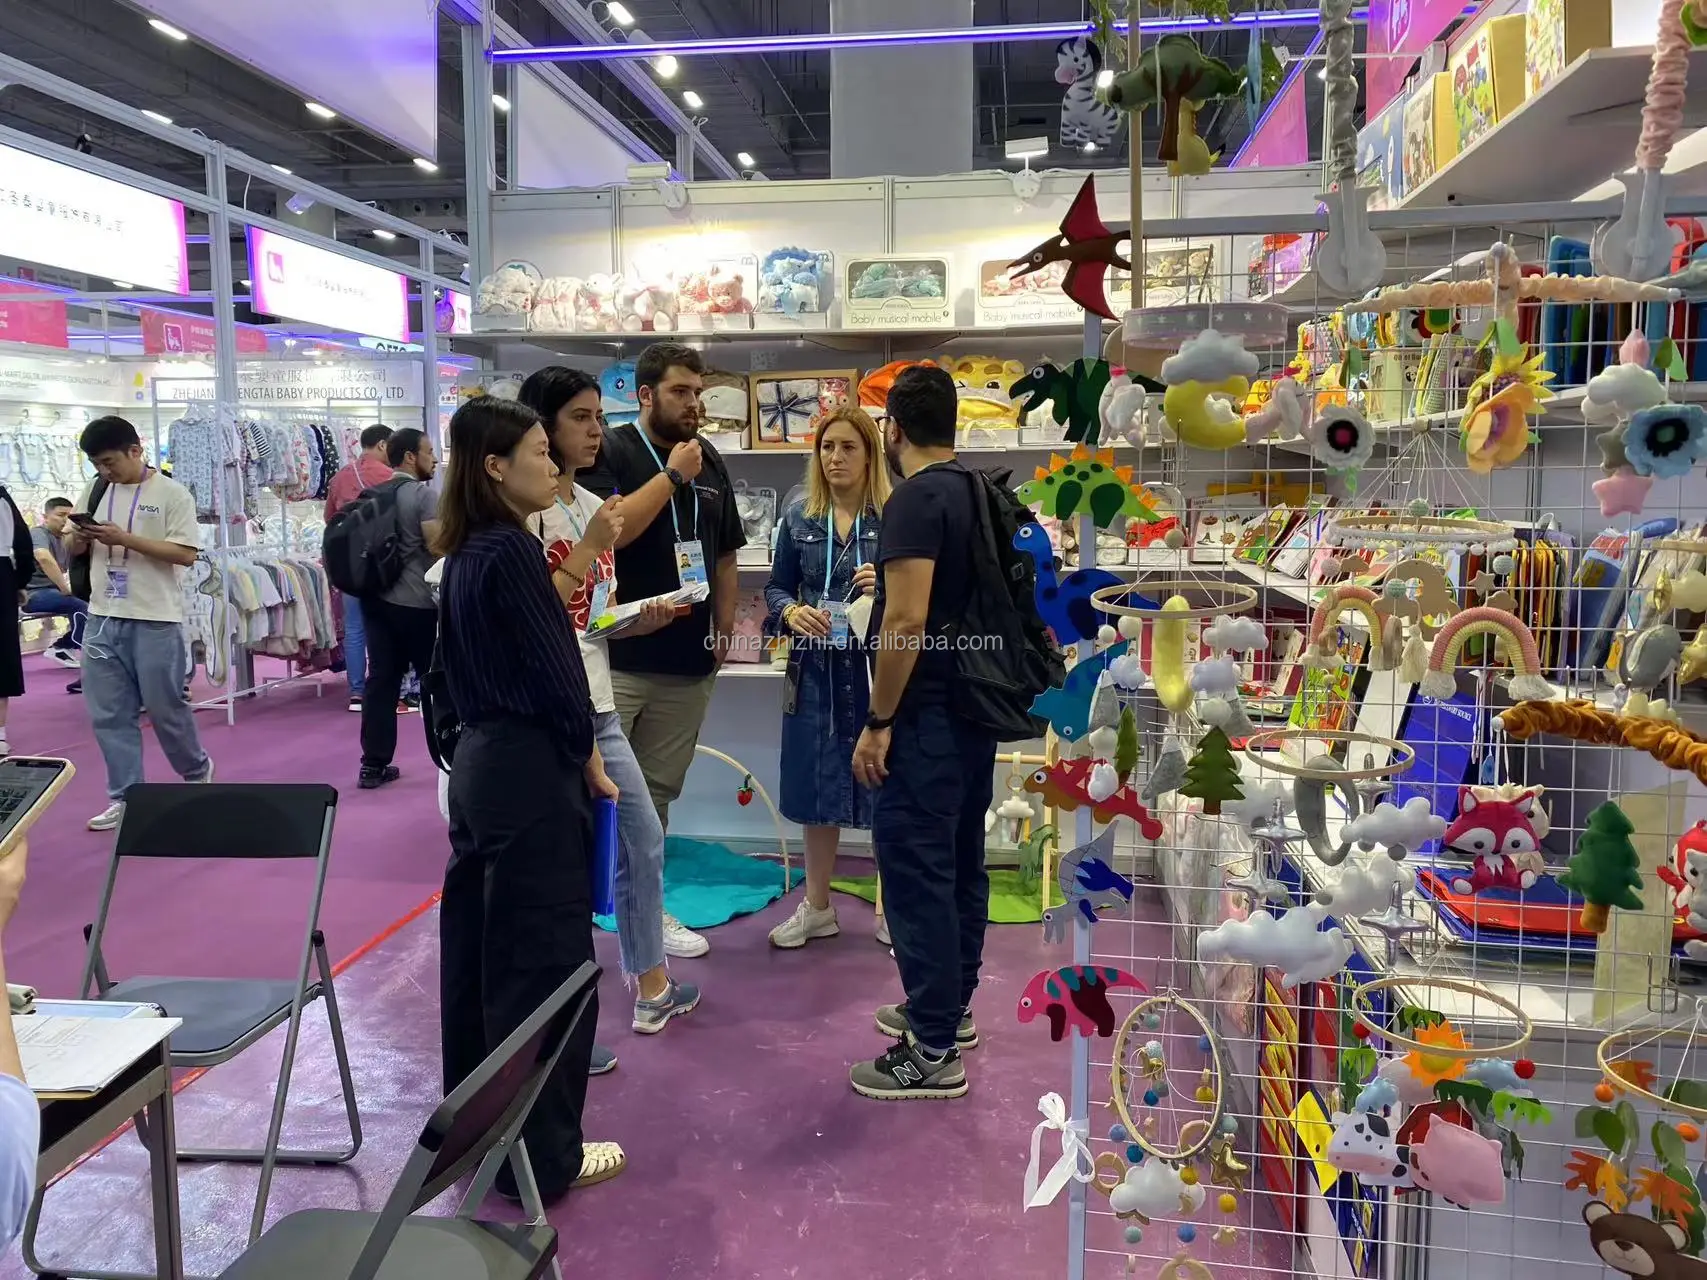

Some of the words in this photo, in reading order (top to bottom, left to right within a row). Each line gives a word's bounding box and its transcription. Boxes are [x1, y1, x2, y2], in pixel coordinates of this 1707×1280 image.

[851, 314, 875, 325] Baby
[878, 313, 909, 323] musical
[912, 312, 941, 322] mobile
[983, 311, 1007, 322] Baby
[1045, 308, 1075, 319] mobile
[173, 387, 215, 399] ZHEJIAN
[237, 387, 273, 399] ENGTAI
[276, 387, 303, 399] BABY
[307, 386, 360, 399] PRODUCTS
[386, 386, 404, 399] LTD
[138, 504, 159, 513] NASA
